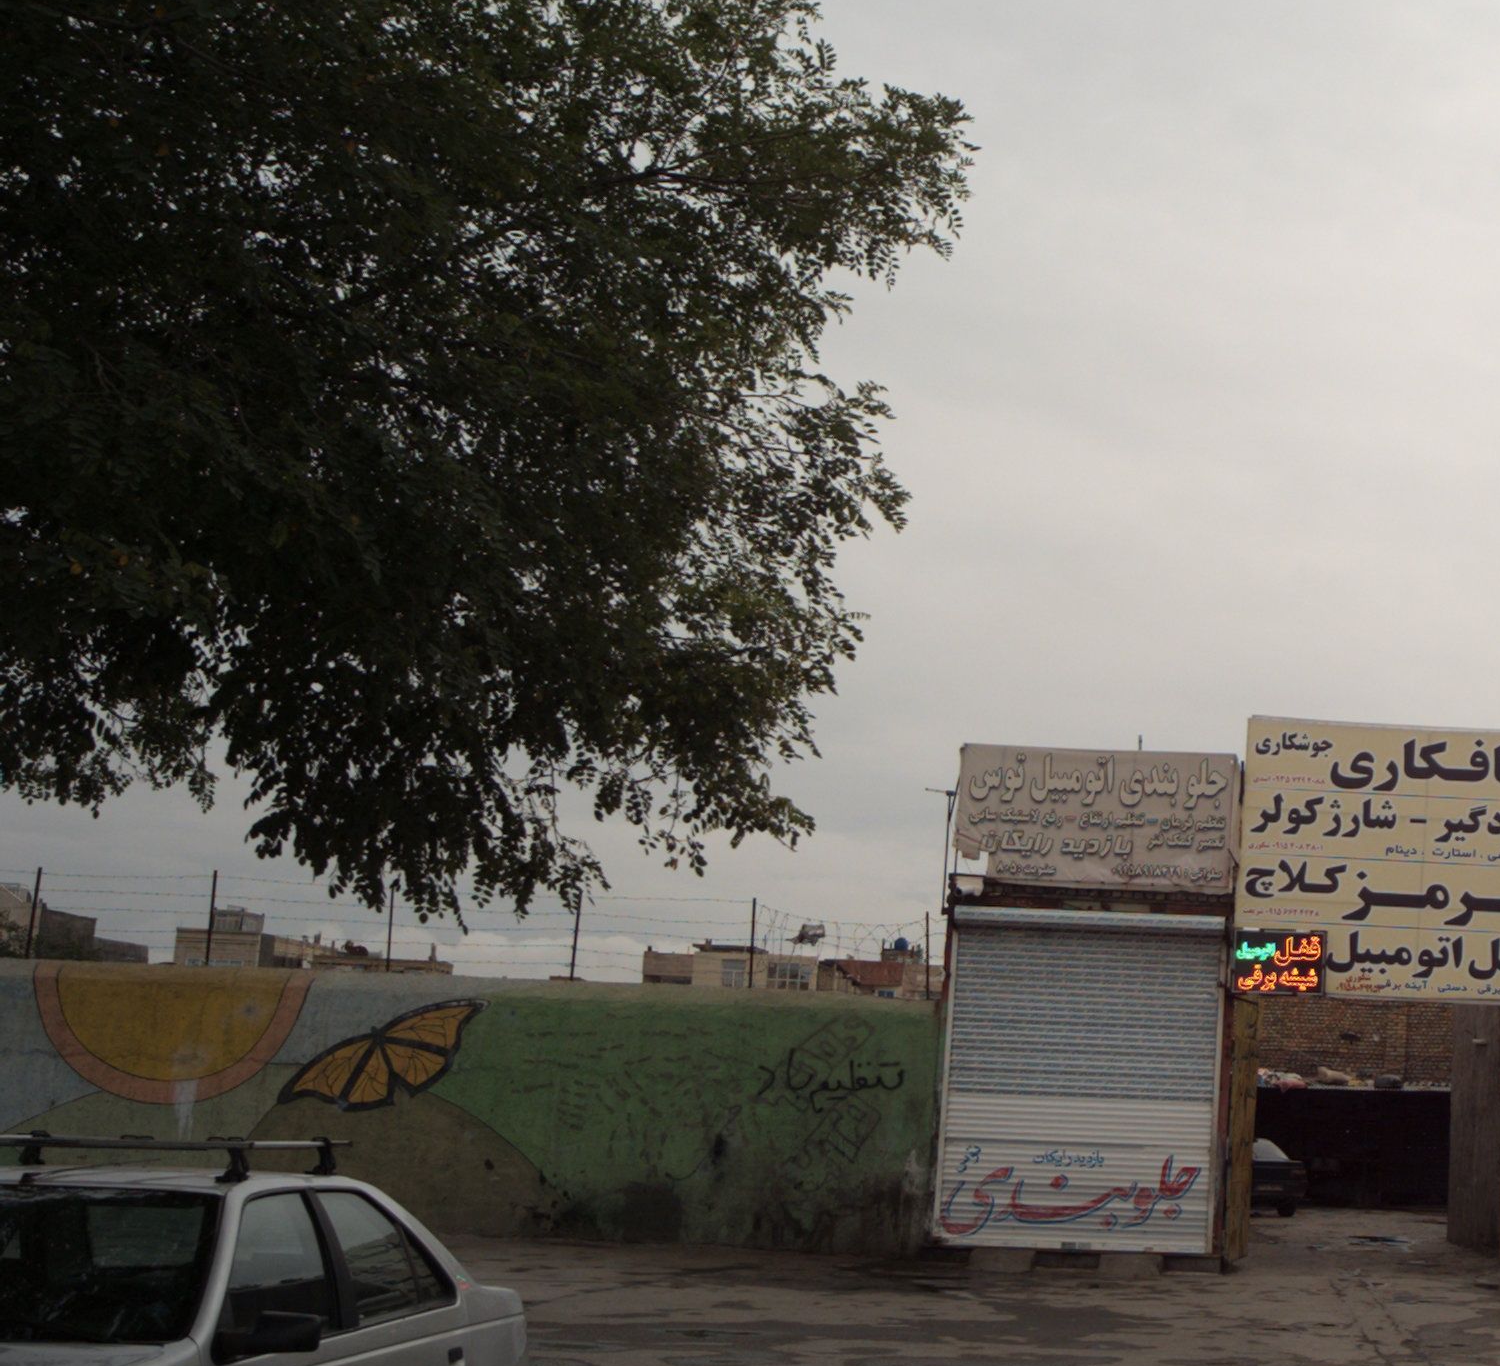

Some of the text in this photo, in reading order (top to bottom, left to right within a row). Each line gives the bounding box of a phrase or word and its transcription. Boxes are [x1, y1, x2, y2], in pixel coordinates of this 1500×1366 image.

[1255, 732, 1334, 758] جوشکاری
[968, 752, 1228, 809] جلو بندی اتومبیل توس
[1160, 812, 1194, 832] فرمان
[1194, 814, 1226, 833] تنظیم
[1250, 792, 1324, 835] کولر
[1322, 799, 1397, 838] شارژ
[980, 829, 1134, 862] بازدید رایگان
[1385, 845, 1418, 857] دینام
[1432, 847, 1477, 859] استارت
[1245, 859, 1347, 898] کلاچ
[1273, 935, 1322, 966] قفل
[1326, 930, 1463, 978] اتومبیل
[1237, 963, 1278, 991] برقی
[1278, 966, 1319, 992] شیشه
[1437, 981, 1468, 993] دستی
[756, 1049, 905, 1114] تنظیم باد
[1032, 1148, 1105, 1168] بازدید رایگان
